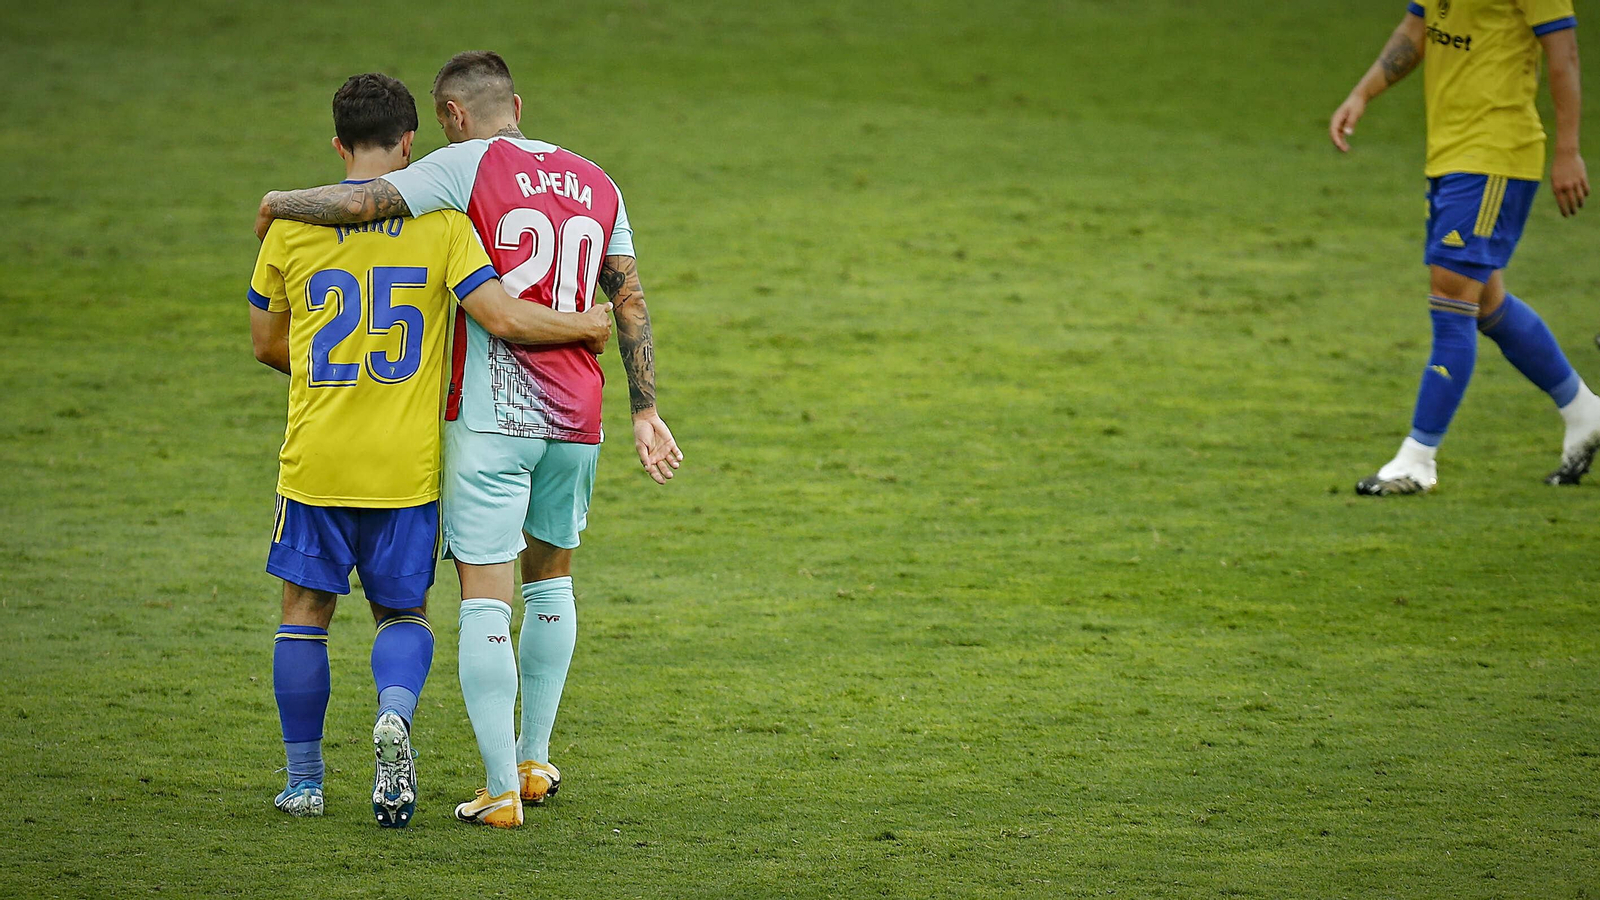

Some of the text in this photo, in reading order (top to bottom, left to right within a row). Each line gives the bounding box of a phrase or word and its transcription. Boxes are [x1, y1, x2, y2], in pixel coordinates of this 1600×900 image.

[515, 168, 592, 211] R.PEÑA
[494, 207, 605, 313] 20
[304, 266, 428, 388] 25
